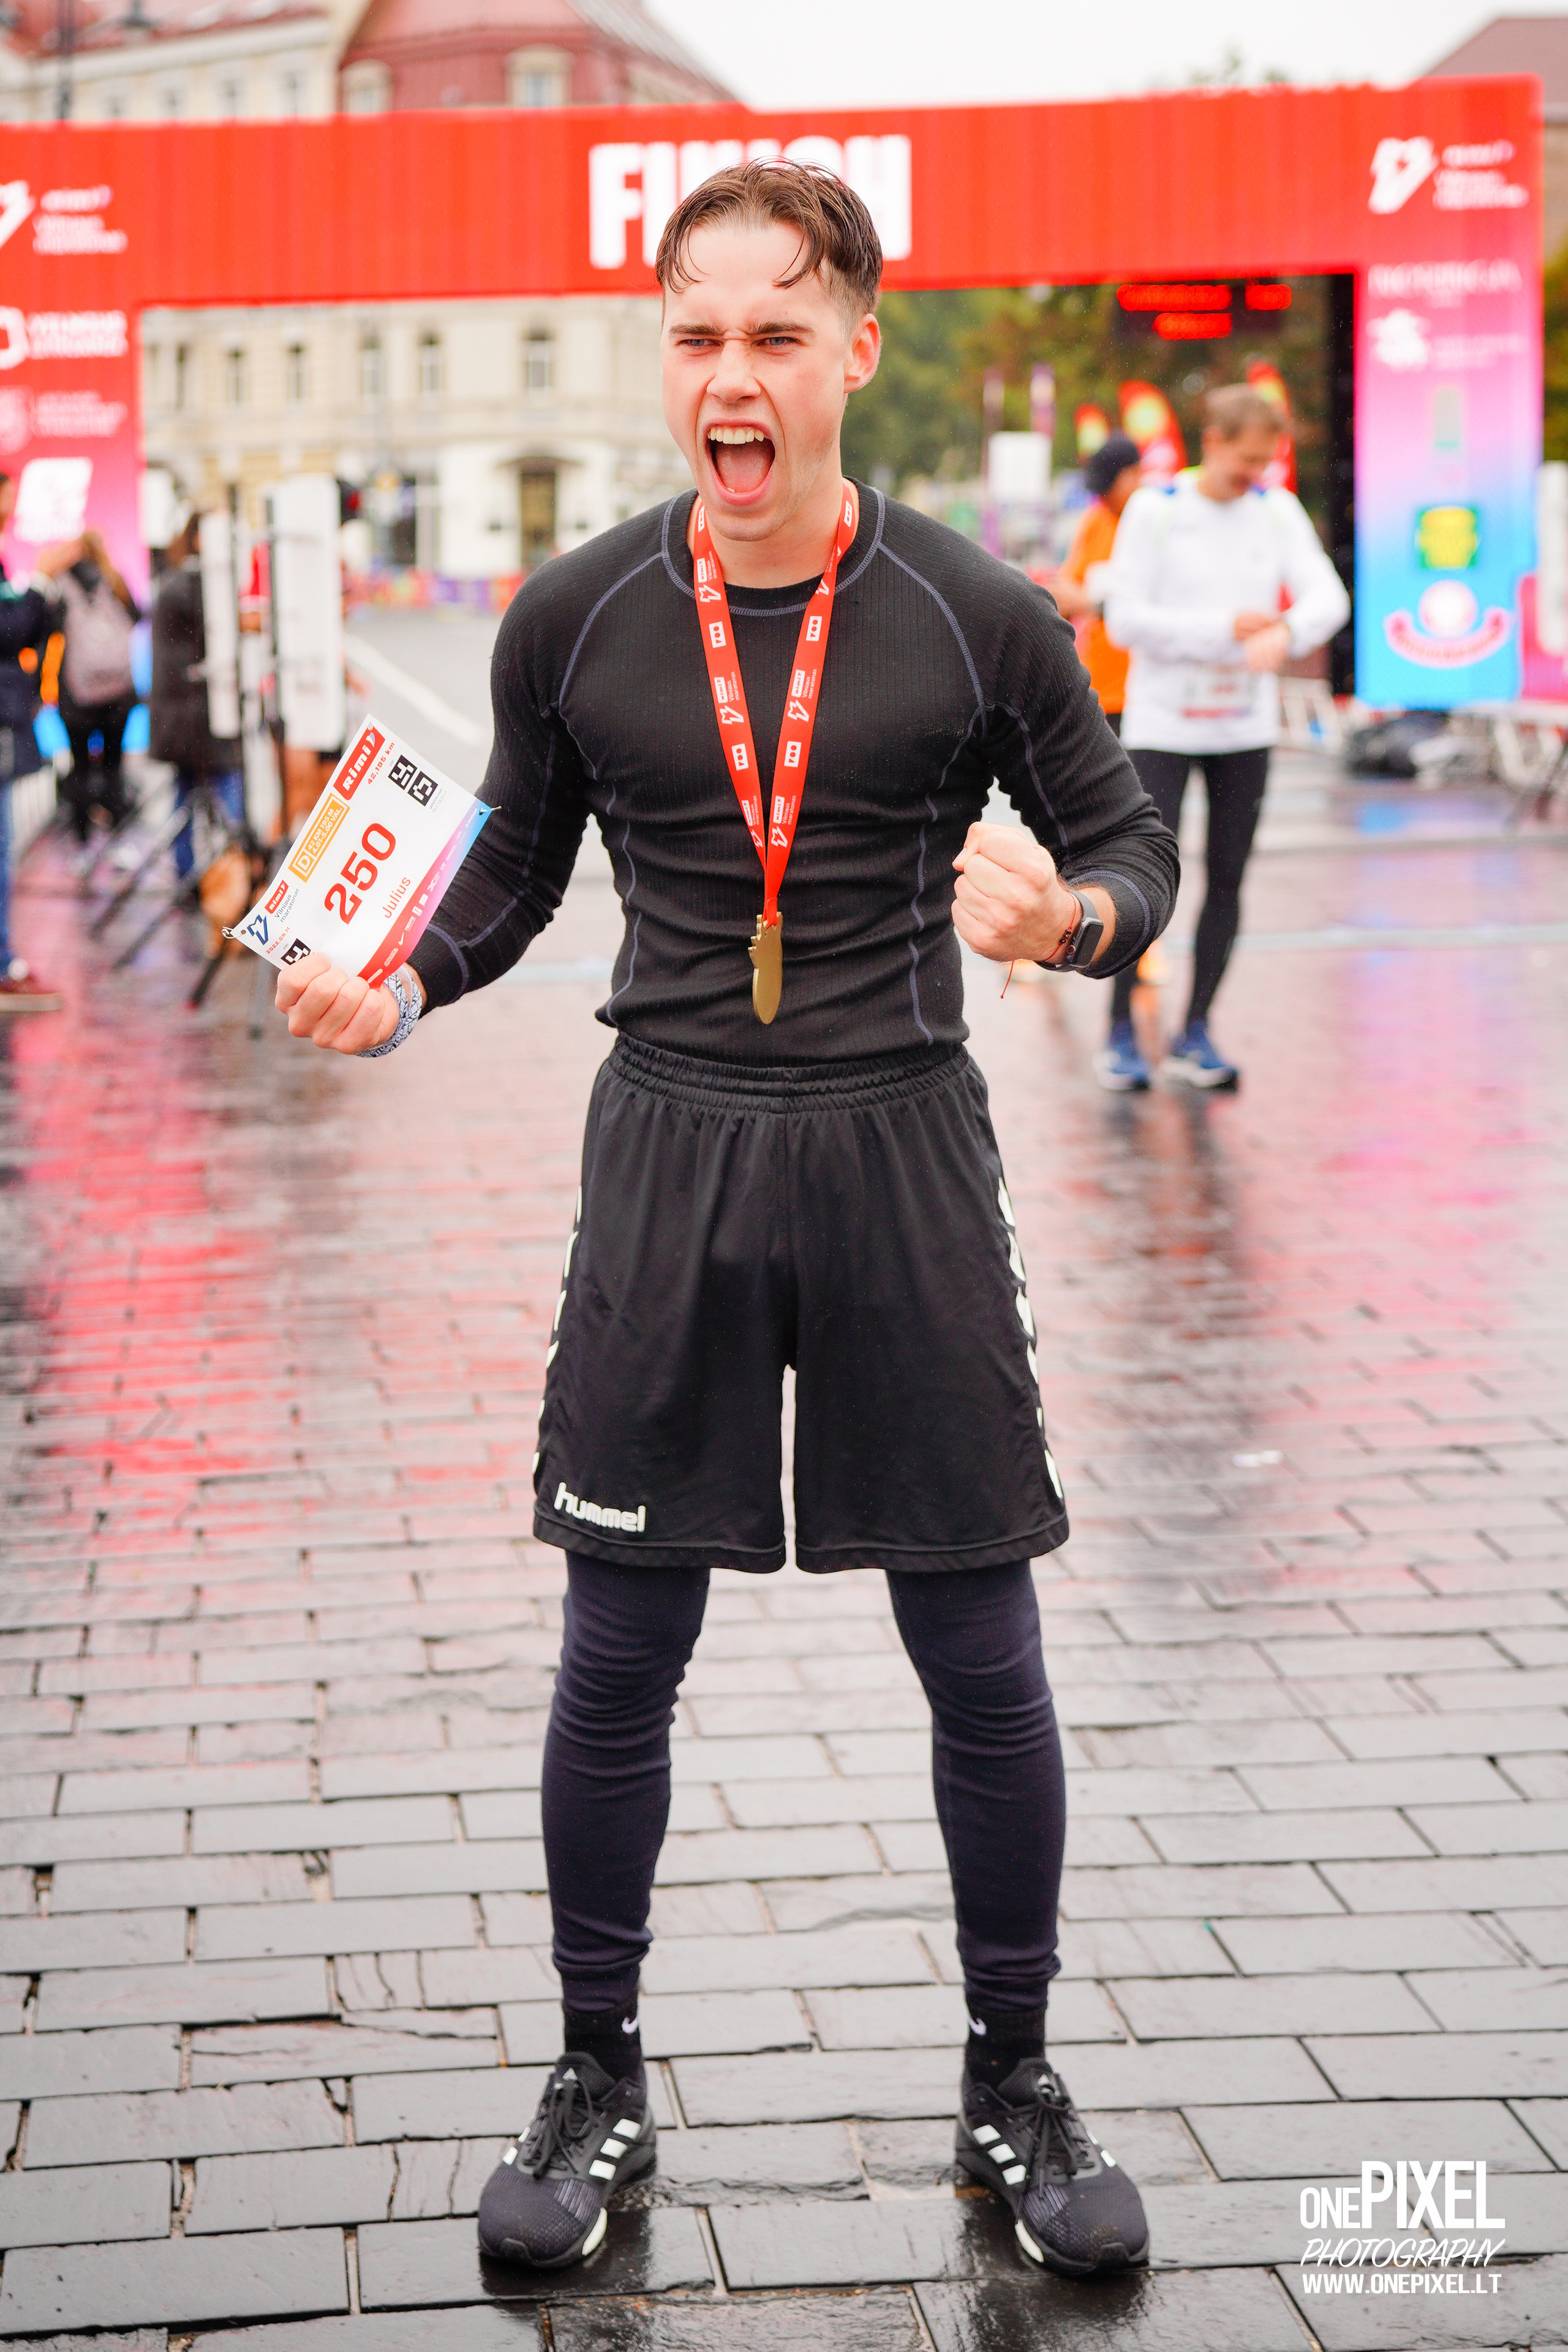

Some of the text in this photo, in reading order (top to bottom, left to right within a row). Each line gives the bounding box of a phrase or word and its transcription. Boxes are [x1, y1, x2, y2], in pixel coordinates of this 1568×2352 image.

[589, 135, 912, 268] FIH
[368, 742, 394, 784] 42,195 km
[308, 840, 315, 850] 42
[314, 829, 323, 840] KM
[320, 816, 330, 828] 195
[313, 807, 342, 853] 4.01-5.00 VAL.
[297, 854, 310, 870] D
[324, 823, 396, 925] 250
[274, 894, 292, 917] Vilniaus
[281, 888, 299, 922] maratonas
[382, 876, 411, 918] Julius
[554, 1482, 646, 1532] hummel
